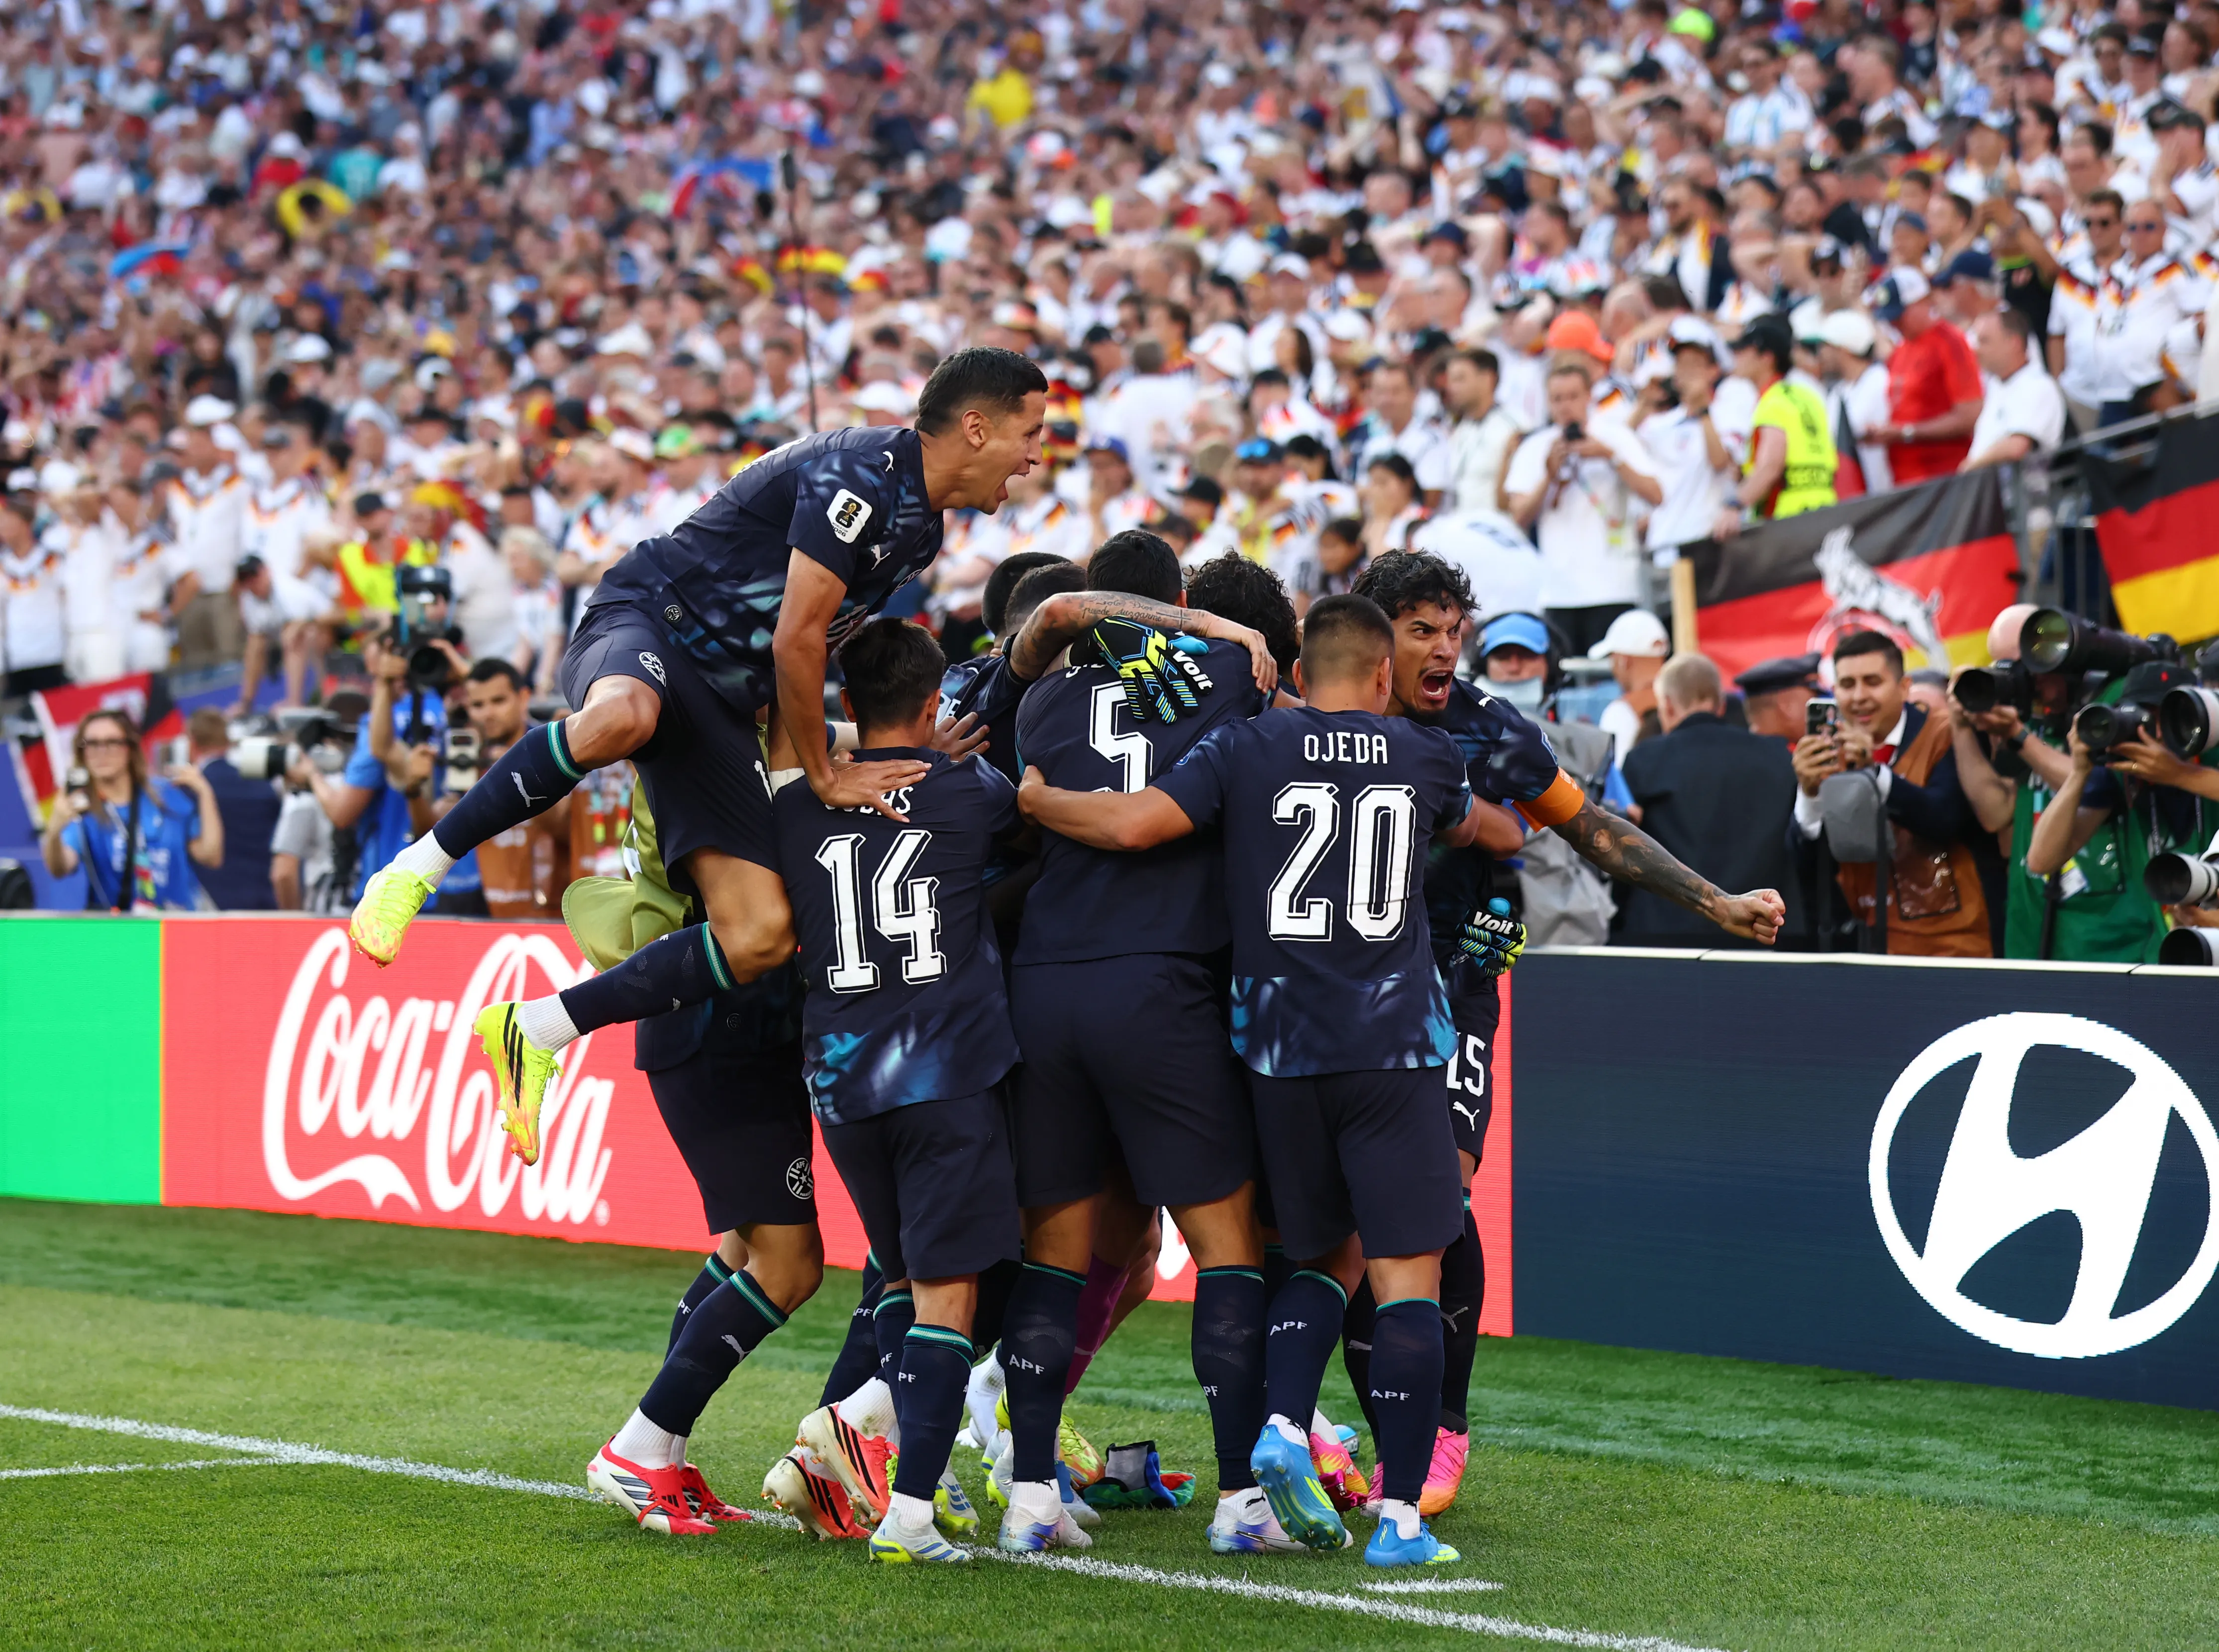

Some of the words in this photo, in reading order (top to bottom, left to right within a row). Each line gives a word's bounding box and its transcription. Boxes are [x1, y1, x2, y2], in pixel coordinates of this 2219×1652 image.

[1173, 650, 1213, 690] Voit
[1304, 731, 1388, 764] OJEDA
[1267, 782, 1416, 941] 20
[814, 829, 947, 994] 14
[1473, 911, 1514, 935] Voit
[796, 1160, 806, 1169] APF
[1270, 1321, 1308, 1337] APF
[1009, 1354, 1045, 1375] APF
[1371, 1389, 1411, 1401] APF
[1379, 1524, 1388, 1547] F50
